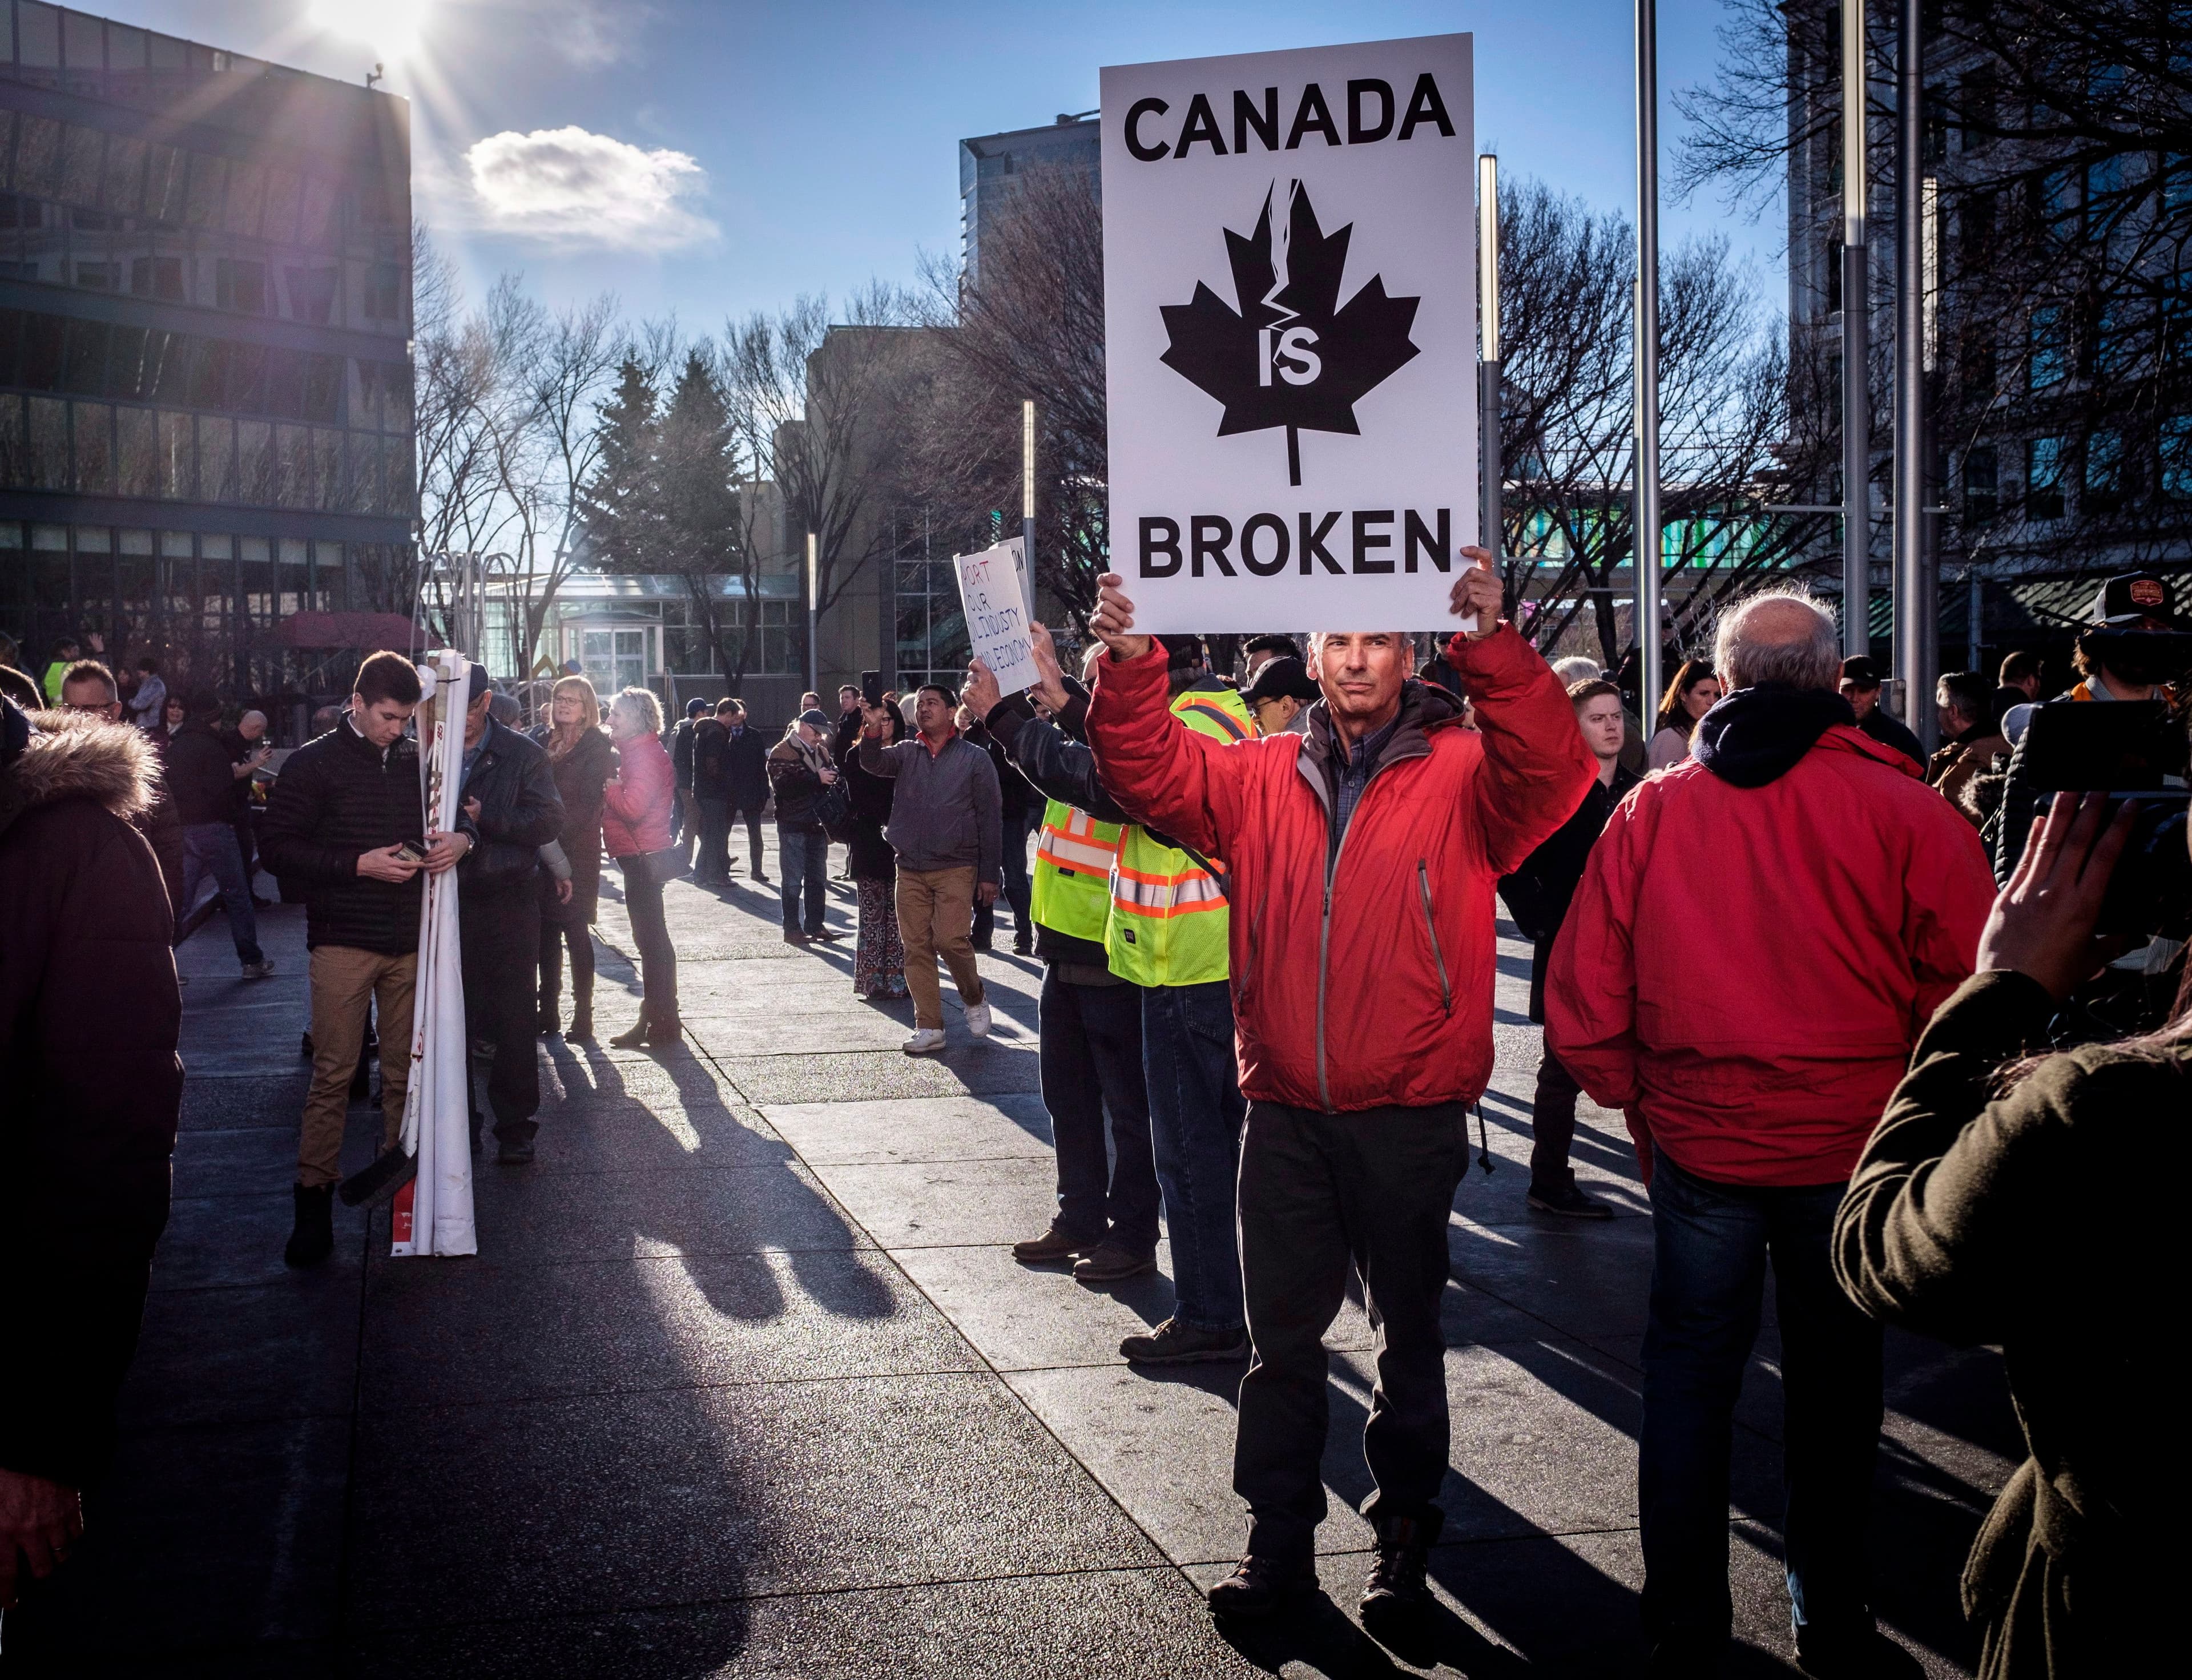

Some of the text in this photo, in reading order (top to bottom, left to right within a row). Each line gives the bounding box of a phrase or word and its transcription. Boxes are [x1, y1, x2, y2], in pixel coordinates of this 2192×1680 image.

[1124, 72, 1457, 162] CANADA
[1259, 327, 1321, 386] IS
[1139, 508, 1450, 578] BROKEN
[968, 593, 991, 611] OUR
[980, 635, 1033, 671] ND ECONOMY
